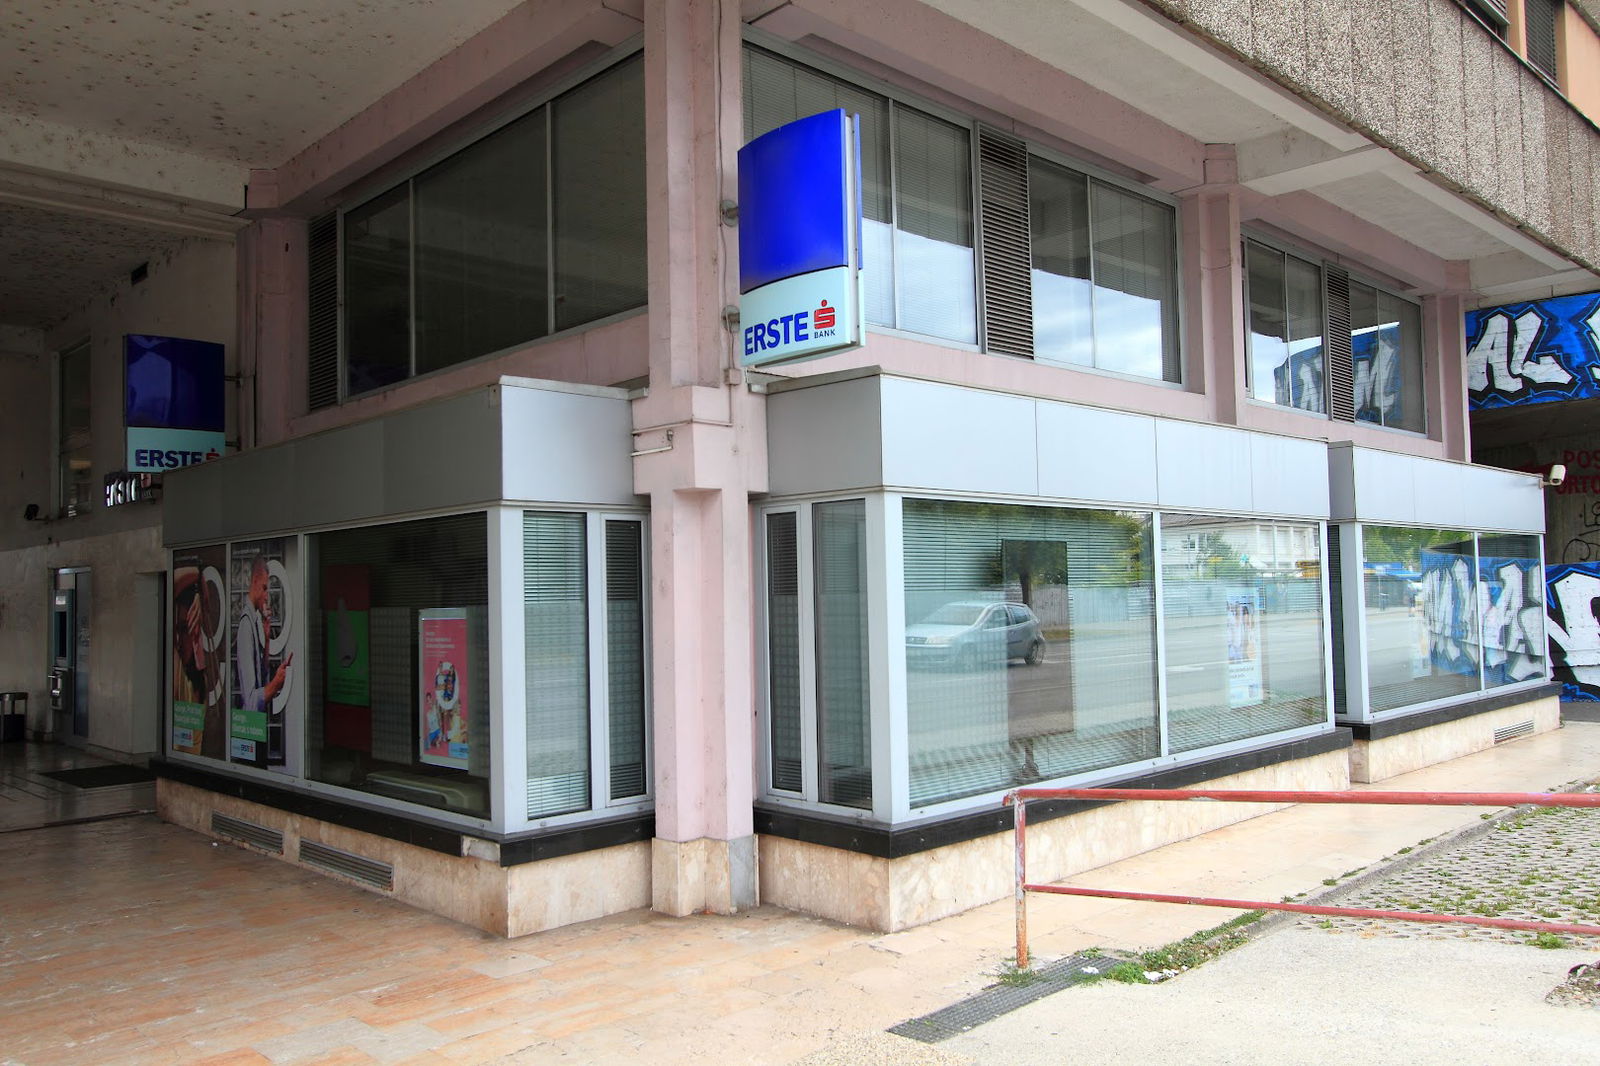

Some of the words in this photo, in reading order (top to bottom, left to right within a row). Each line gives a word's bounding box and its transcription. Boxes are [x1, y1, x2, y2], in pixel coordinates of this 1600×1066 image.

[744, 311, 809, 356] ERSTE
[814, 328, 836, 339] BANK
[135, 449, 202, 468] ERSTE
